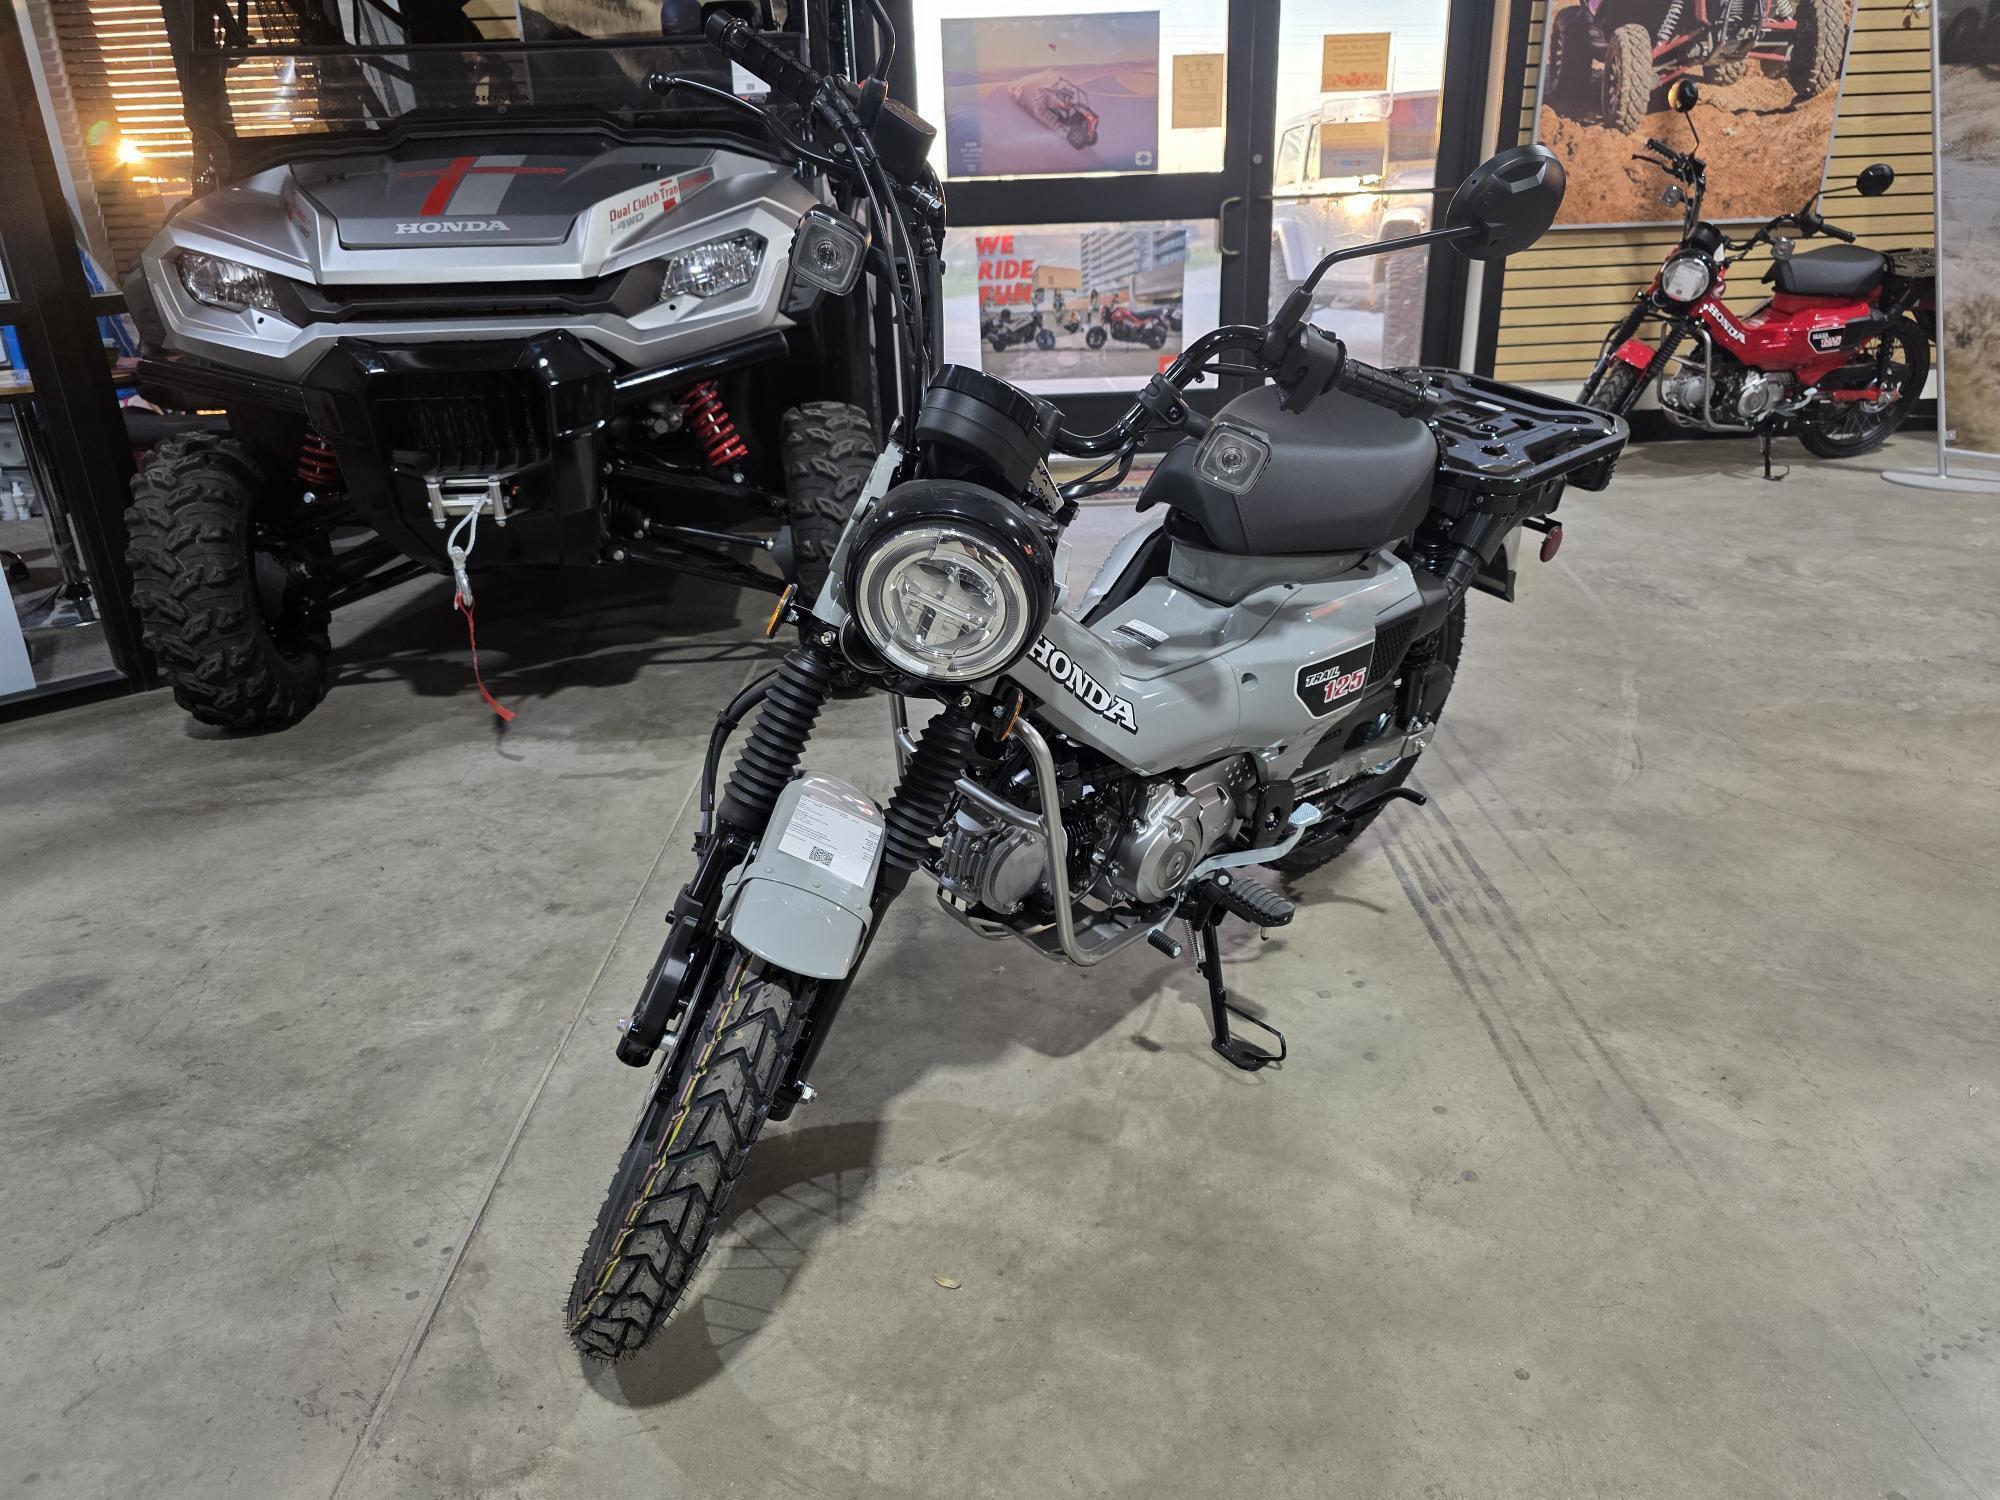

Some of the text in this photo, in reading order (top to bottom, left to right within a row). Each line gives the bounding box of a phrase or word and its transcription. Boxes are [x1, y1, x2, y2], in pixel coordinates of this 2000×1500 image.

[609, 205, 631, 222] Dual
[633, 192, 660, 211] Clutch
[395, 220, 511, 234] HONDA
[976, 235, 1015, 256] WE
[978, 259, 1034, 280] RIDE
[979, 283, 1033, 306] FUN
[1707, 302, 1746, 345] HONDA
[1026, 634, 1139, 735] HONDA
[1305, 665, 1341, 688] TRAIL
[1324, 666, 1367, 703] 125
